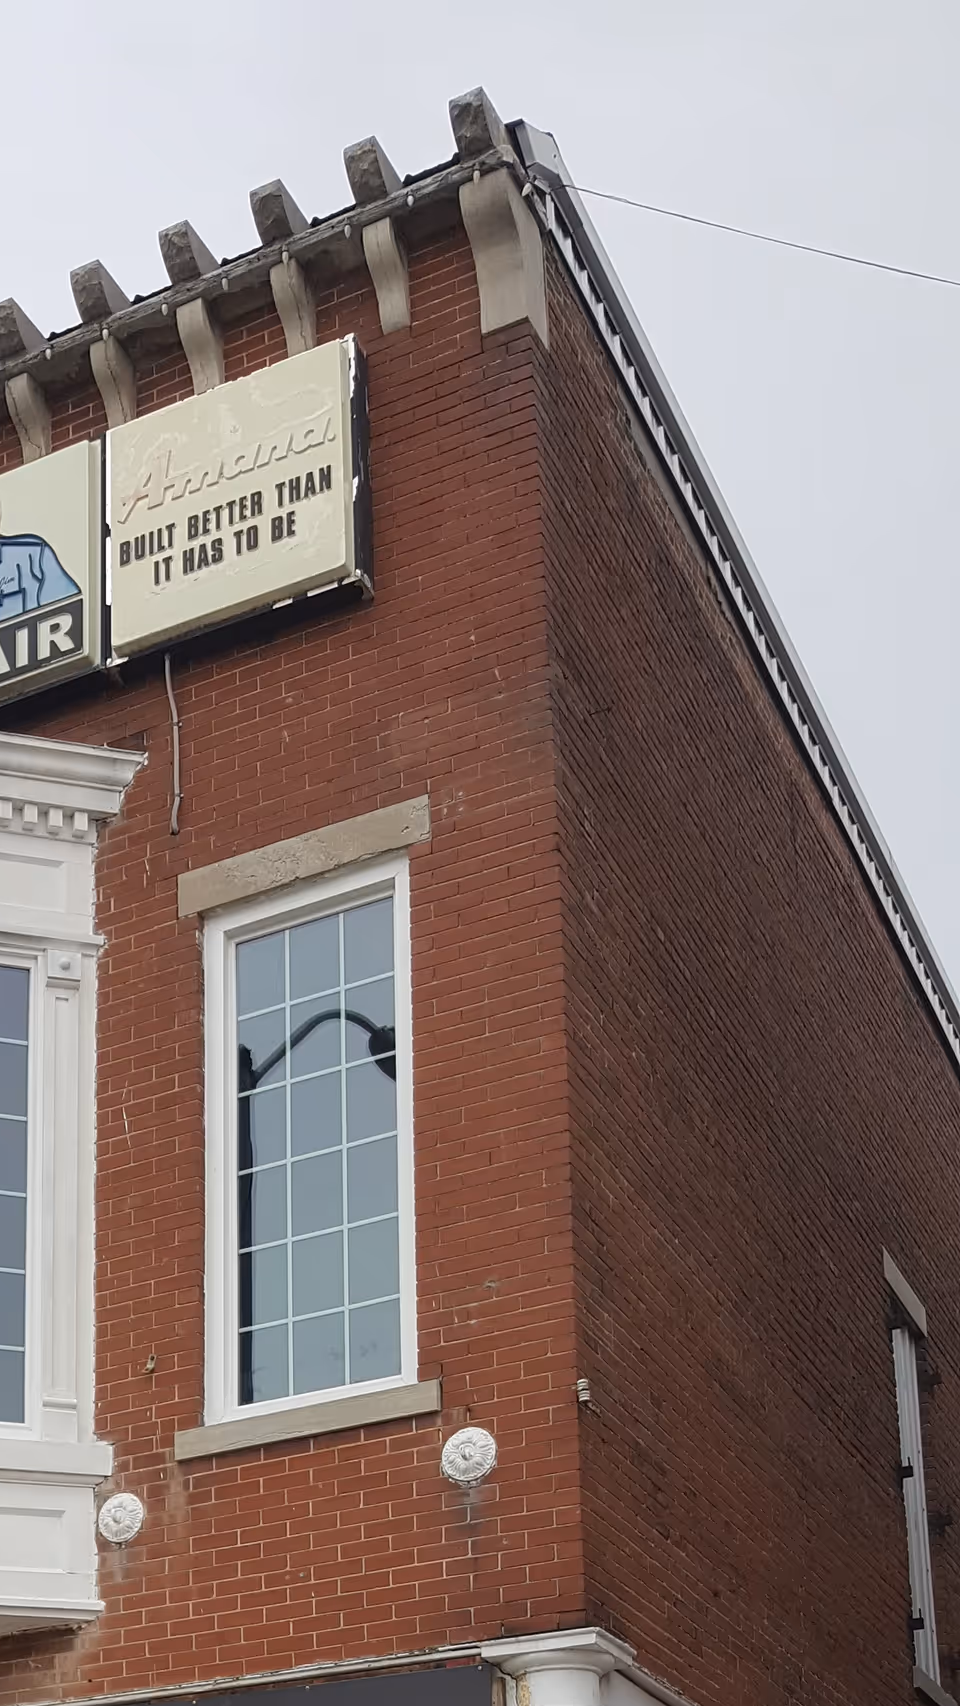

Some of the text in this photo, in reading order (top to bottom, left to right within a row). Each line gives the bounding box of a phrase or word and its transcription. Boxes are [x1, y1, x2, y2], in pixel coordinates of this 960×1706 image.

[117, 416, 336, 524] Amana
[119, 464, 332, 568] BUILT BETTER THAN
[153, 511, 296, 586] IT HAS TO BE
